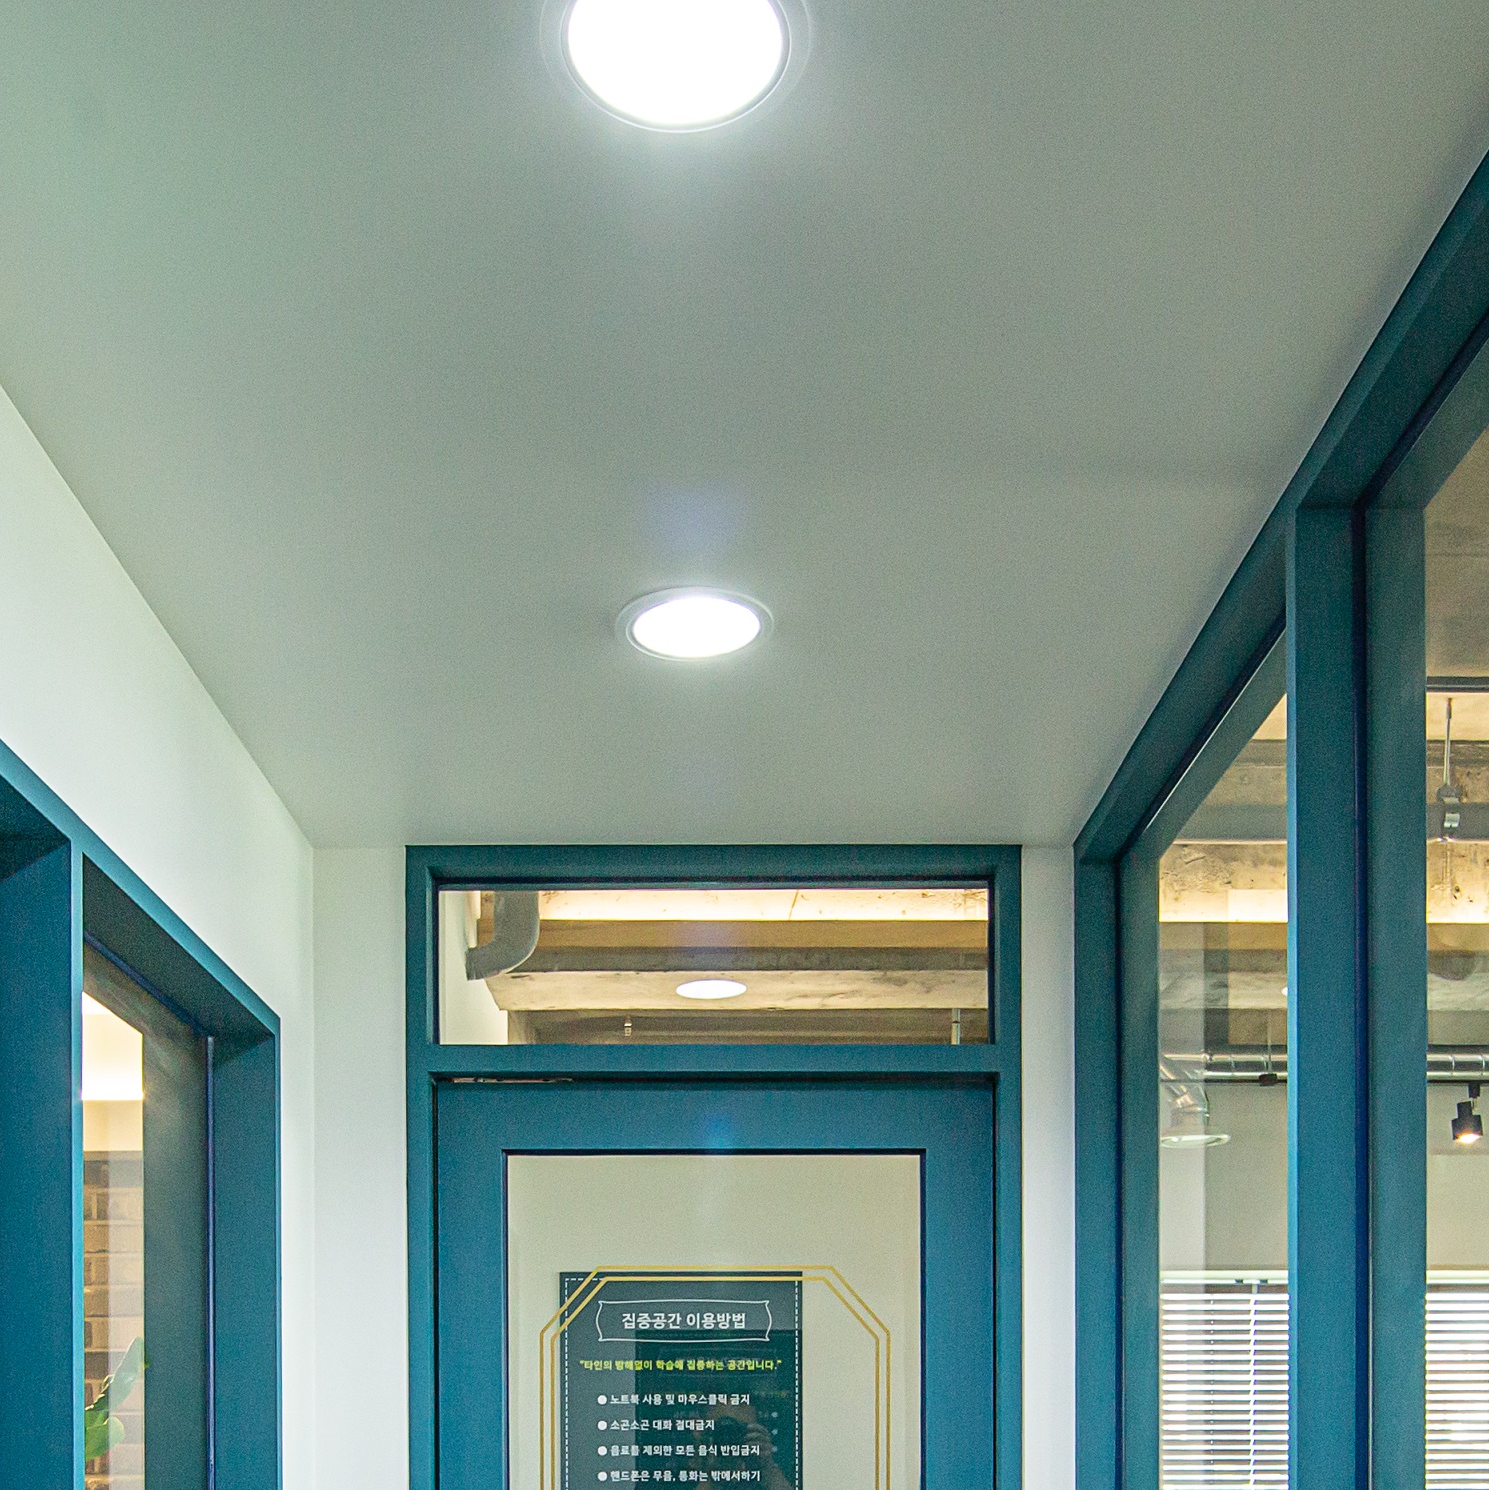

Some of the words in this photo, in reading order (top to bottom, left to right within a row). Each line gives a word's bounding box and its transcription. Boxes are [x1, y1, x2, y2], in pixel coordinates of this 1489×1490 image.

[622, 1312, 682, 1329] 집중공간
[686, 1312, 746, 1329] 이용방법
[610, 1394, 640, 1405] 노트북
[642, 1394, 662, 1406] 사용
[665, 1394, 675, 1405] 및
[730, 1394, 750, 1406] 금지
[610, 1420, 650, 1431] 소곤소곤
[652, 1420, 672, 1431] 대화
[675, 1420, 715, 1431] 절대금지
[611, 1445, 640, 1456] 음료를
[642, 1445, 673, 1456] 제외한
[675, 1445, 695, 1456] 모든
[698, 1445, 718, 1456] 음식
[720, 1445, 760, 1456] 반입금지
[610, 1470, 651, 1482] 핸드폰은
[679, 1470, 708, 1482] 통화는
[711, 1470, 761, 1482] 밖에서하기
